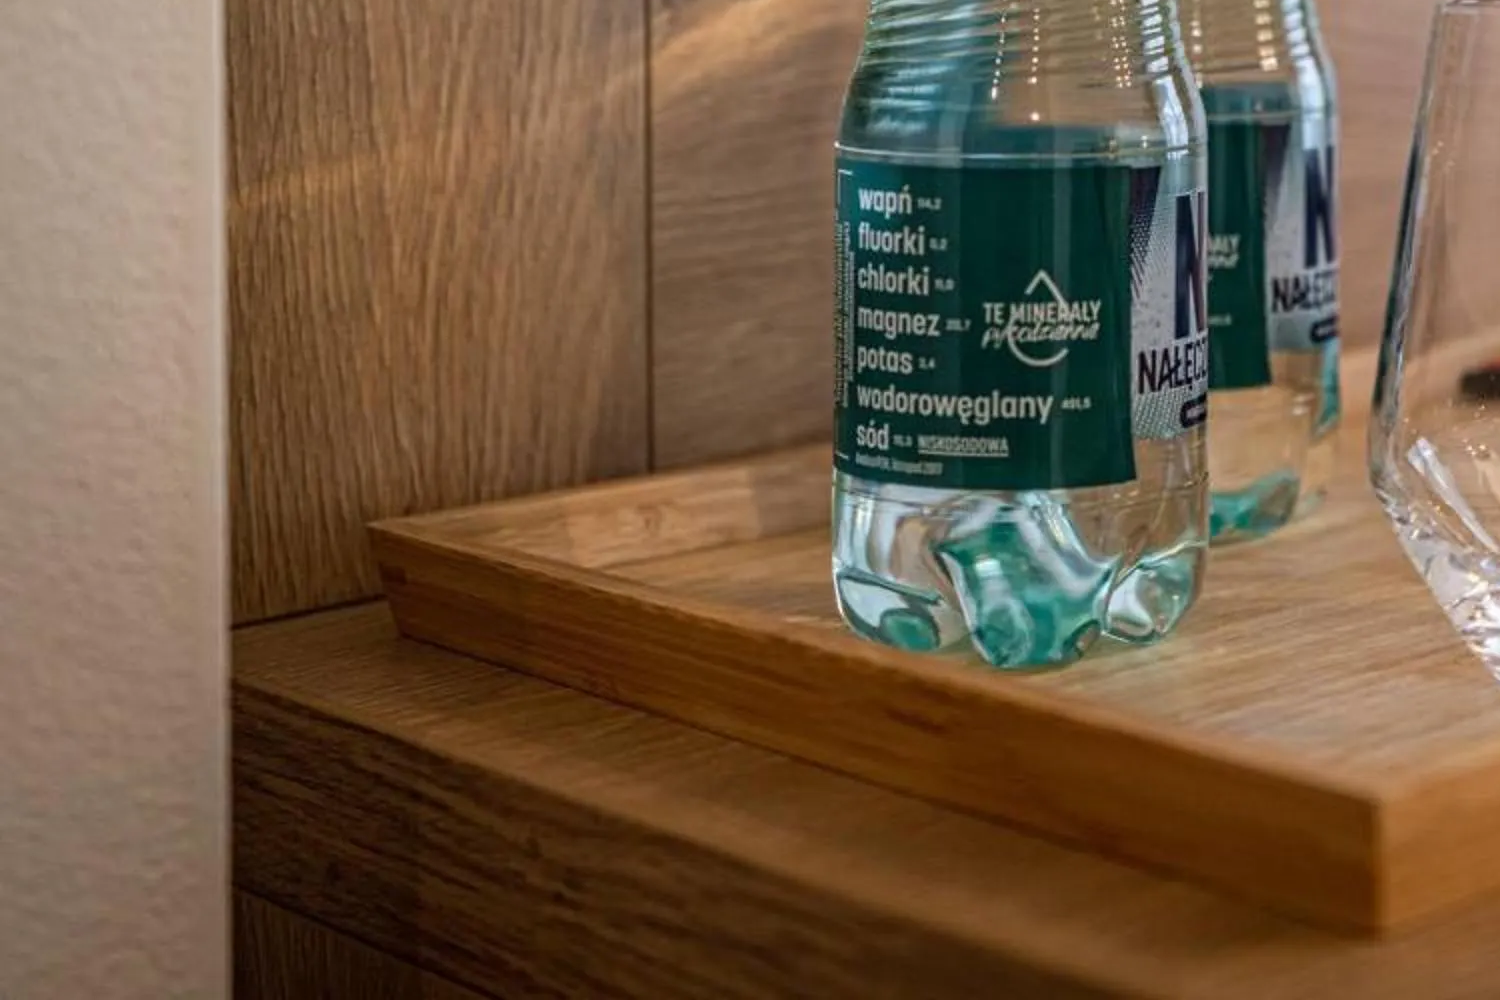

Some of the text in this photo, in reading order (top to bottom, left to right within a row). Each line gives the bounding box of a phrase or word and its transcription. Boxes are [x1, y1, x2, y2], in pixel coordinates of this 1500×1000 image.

[858, 184, 913, 219] wapń
[858, 221, 925, 256] fluorki
[857, 262, 930, 296] chlorki
[857, 305, 941, 340] magnez
[982, 301, 1005, 325] TE
[857, 345, 913, 375] potas
[857, 384, 1054, 425] wodorowęglany
[856, 419, 889, 450] sód
